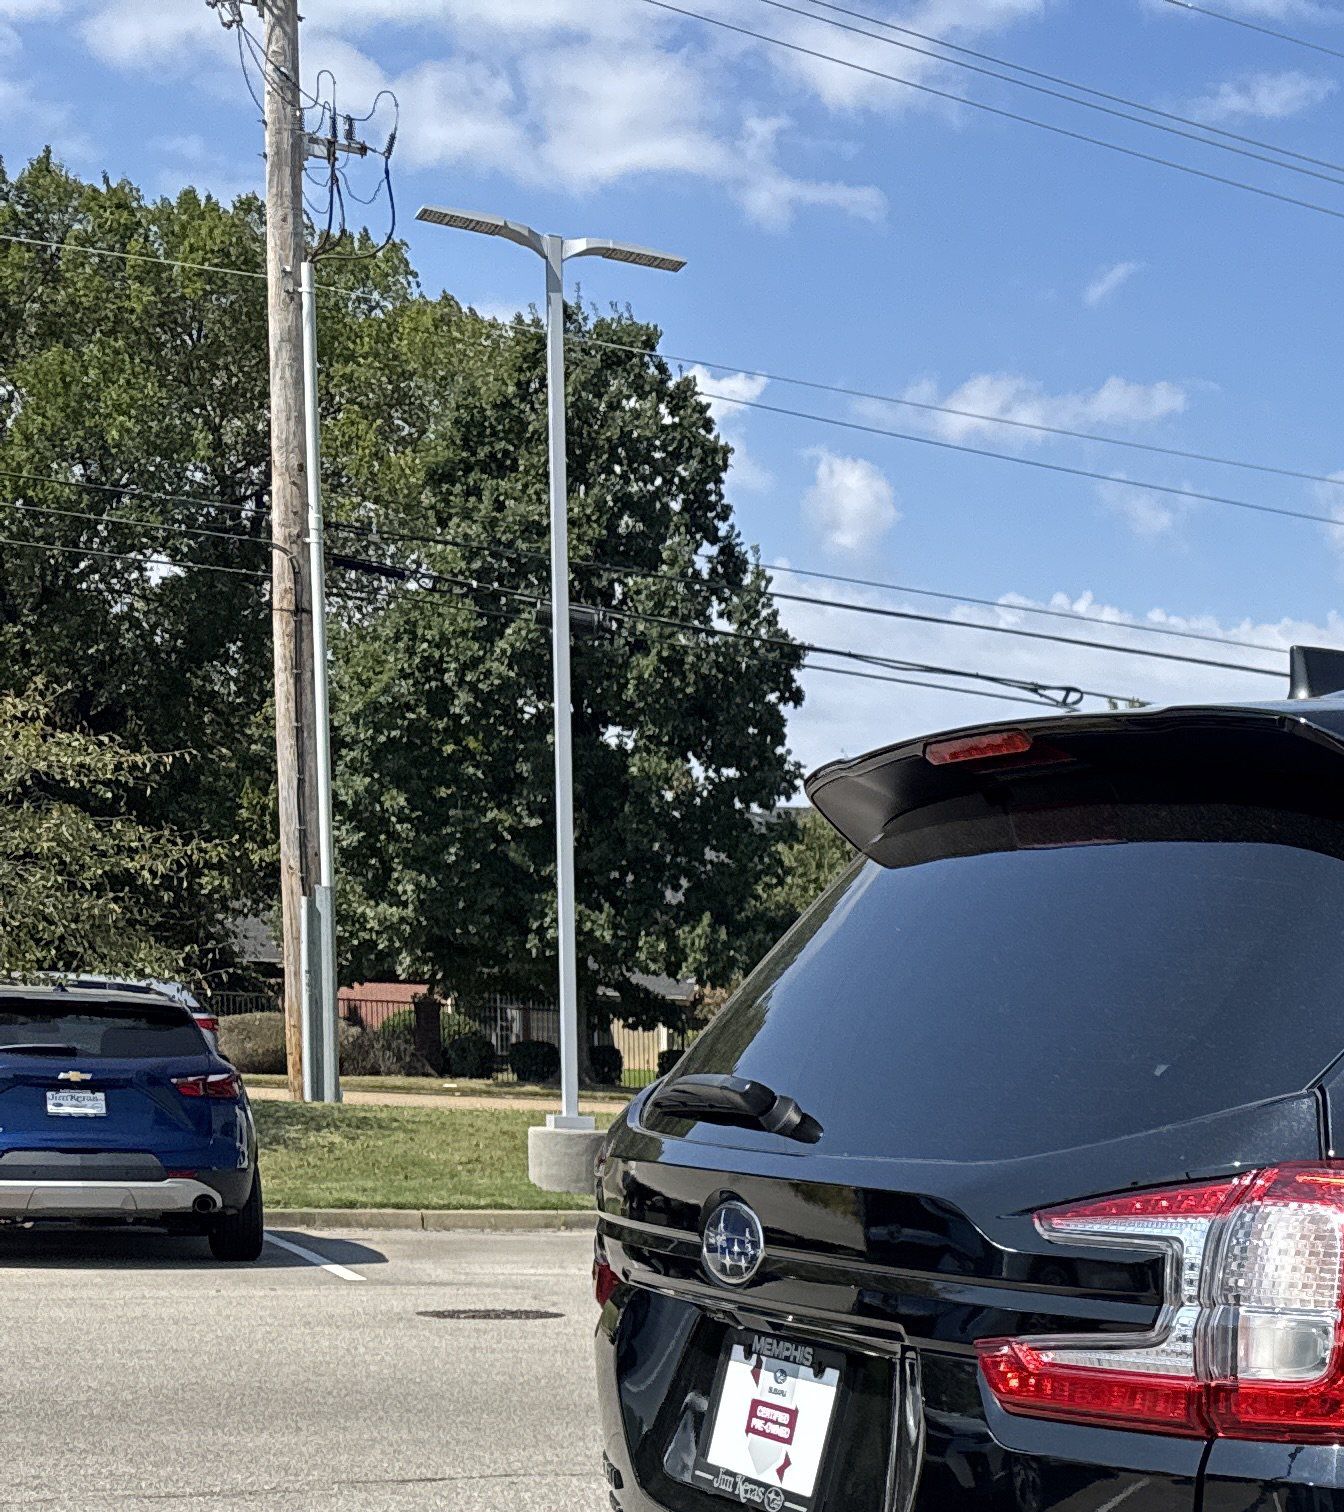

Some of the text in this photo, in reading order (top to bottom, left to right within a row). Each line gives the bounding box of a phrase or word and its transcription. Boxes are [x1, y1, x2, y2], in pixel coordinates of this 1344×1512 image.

[752, 1334, 814, 1366] MEMPHIS
[713, 1467, 766, 1503] Jim Keras
